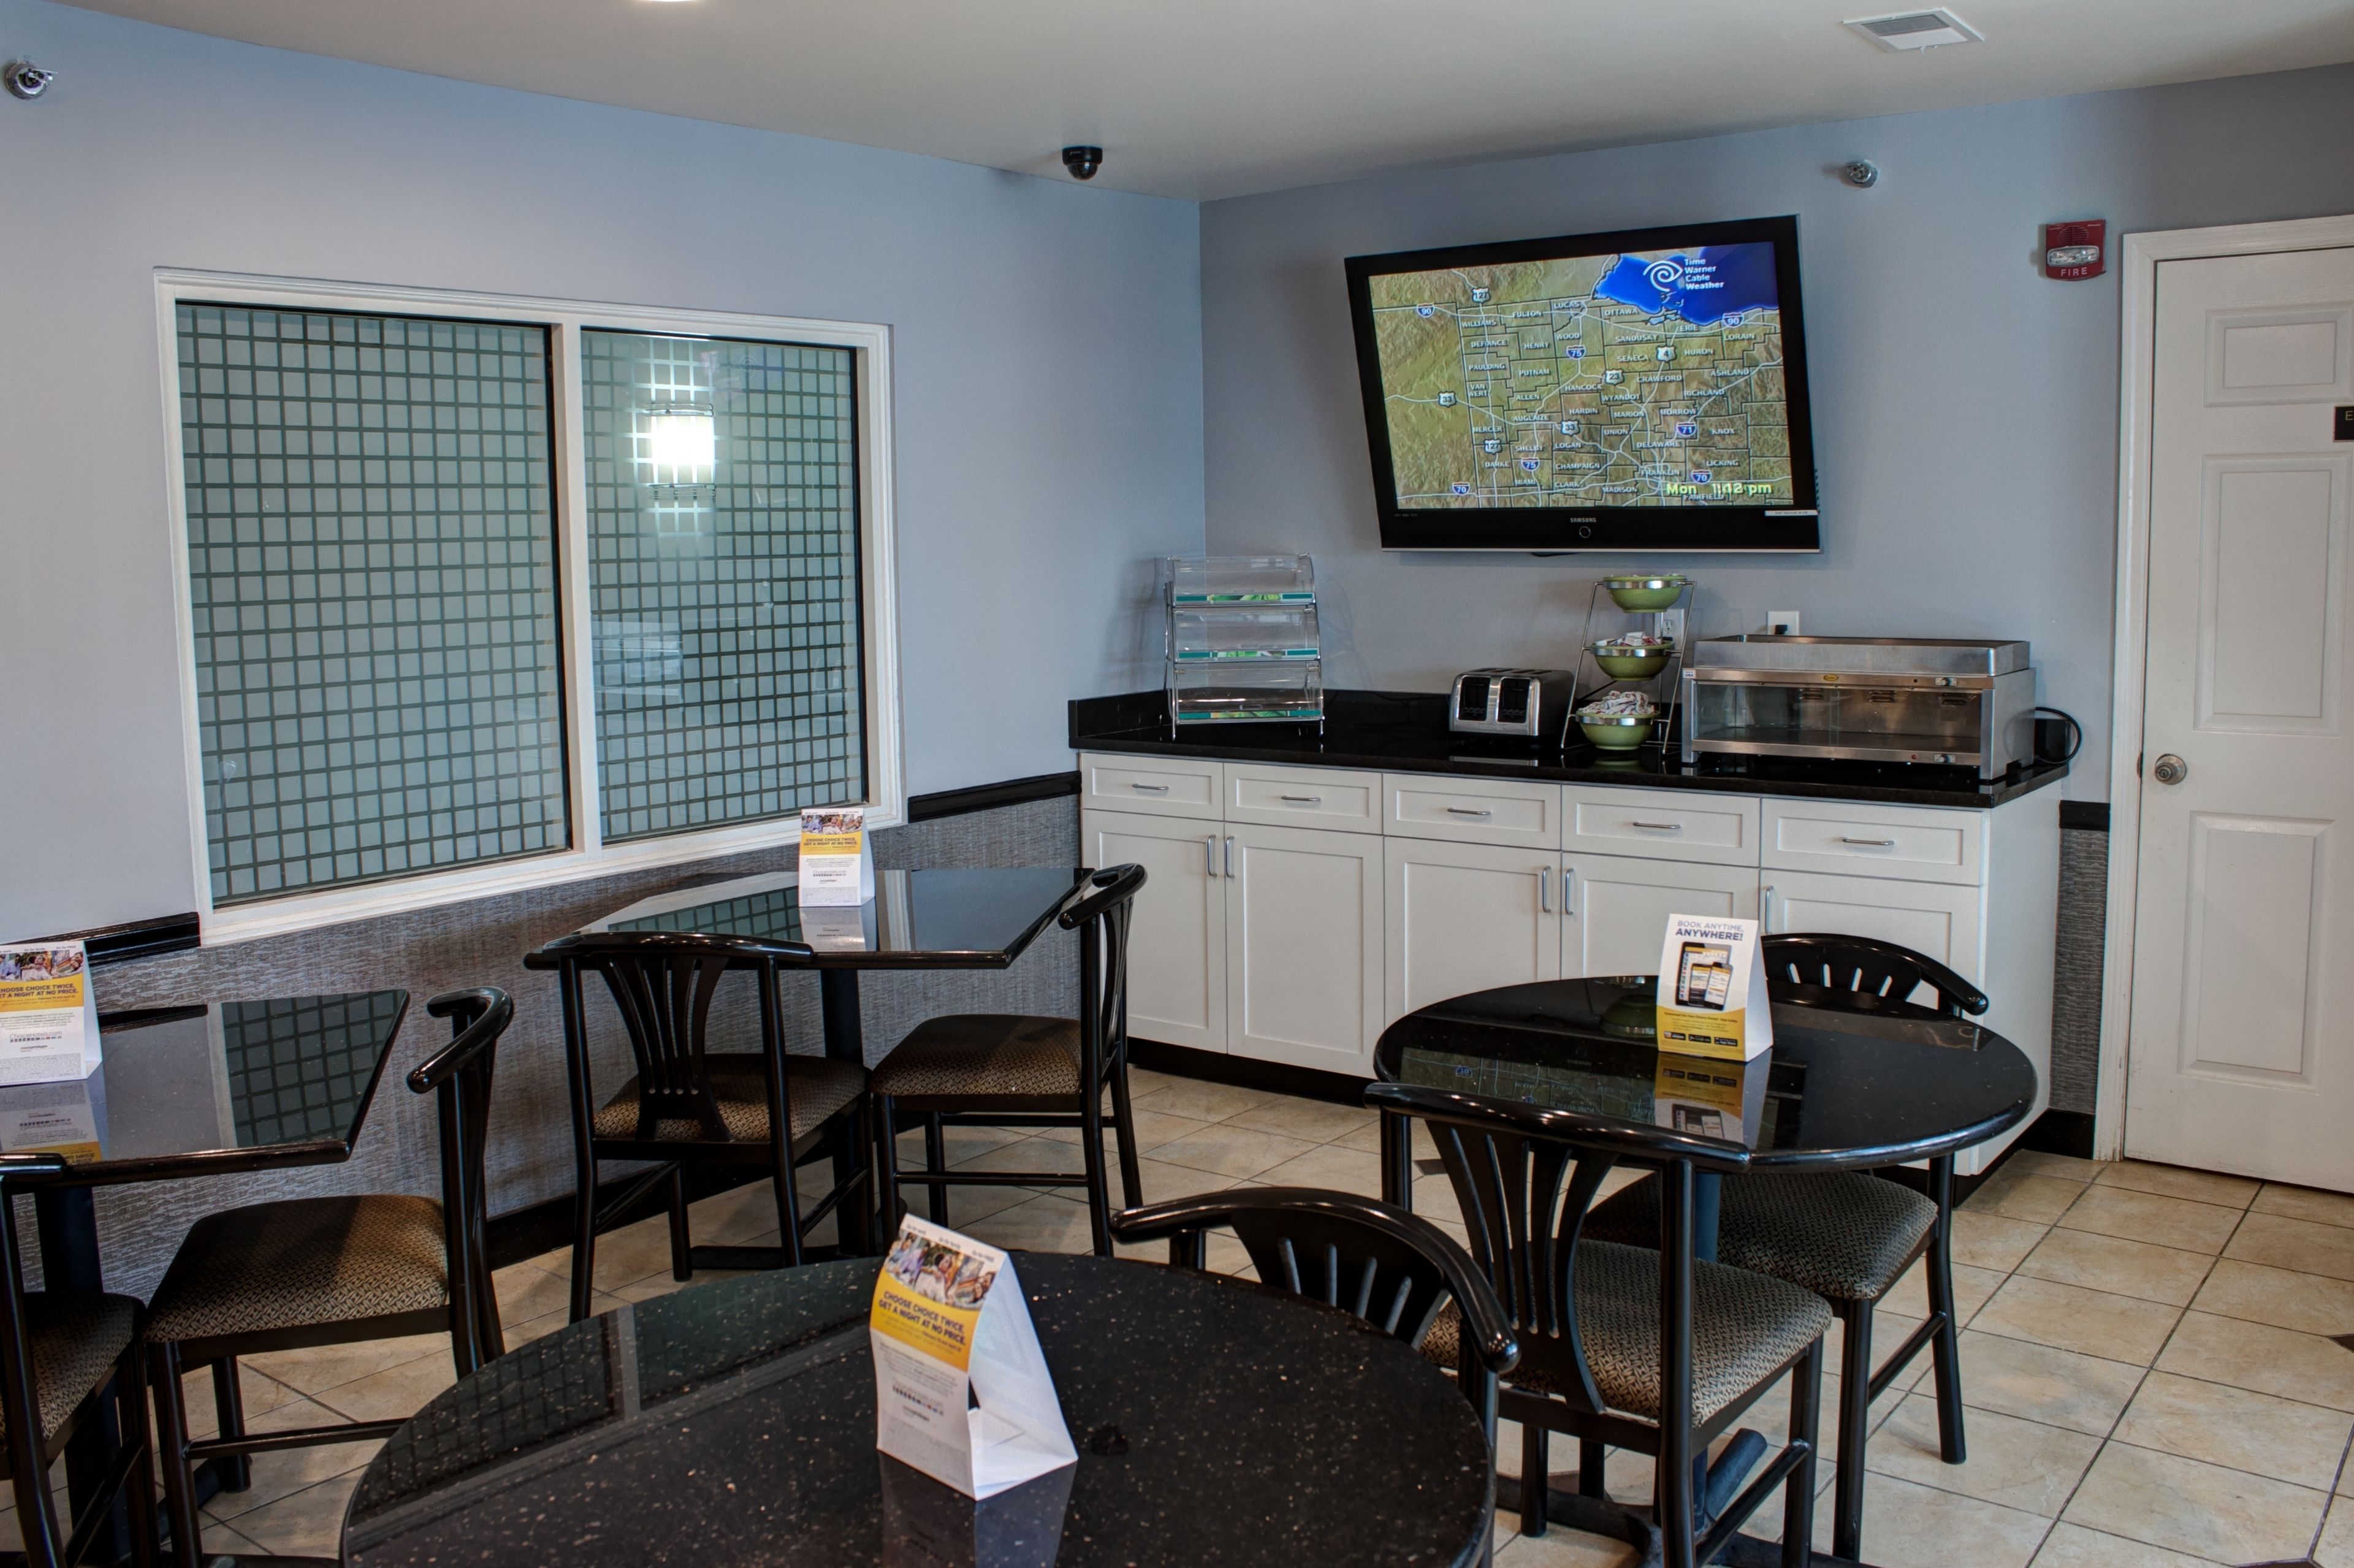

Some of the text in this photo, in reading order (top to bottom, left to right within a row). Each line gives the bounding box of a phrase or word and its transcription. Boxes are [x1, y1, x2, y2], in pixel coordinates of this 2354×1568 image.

[2060, 267, 2087, 276] FIRE
[1686, 281, 1724, 290] Weather
[1461, 319, 1496, 328] WILLIAMS
[1615, 334, 1658, 343] SANDUSKY
[1471, 340, 1508, 348] DEFIANCE
[1666, 482, 1697, 495] Mon
[1748, 483, 1773, 498] pm
[1677, 920, 1702, 929] BOOK
[1675, 928, 1743, 942] ANYWHERE!
[884, 1290, 912, 1309] CHOOSE
[913, 1303, 939, 1322] CHOICE
[878, 1299, 892, 1311] GET
[899, 1309, 921, 1325] NIGHT
[921, 1319, 930, 1328] AT
[931, 1323, 942, 1334] NO
